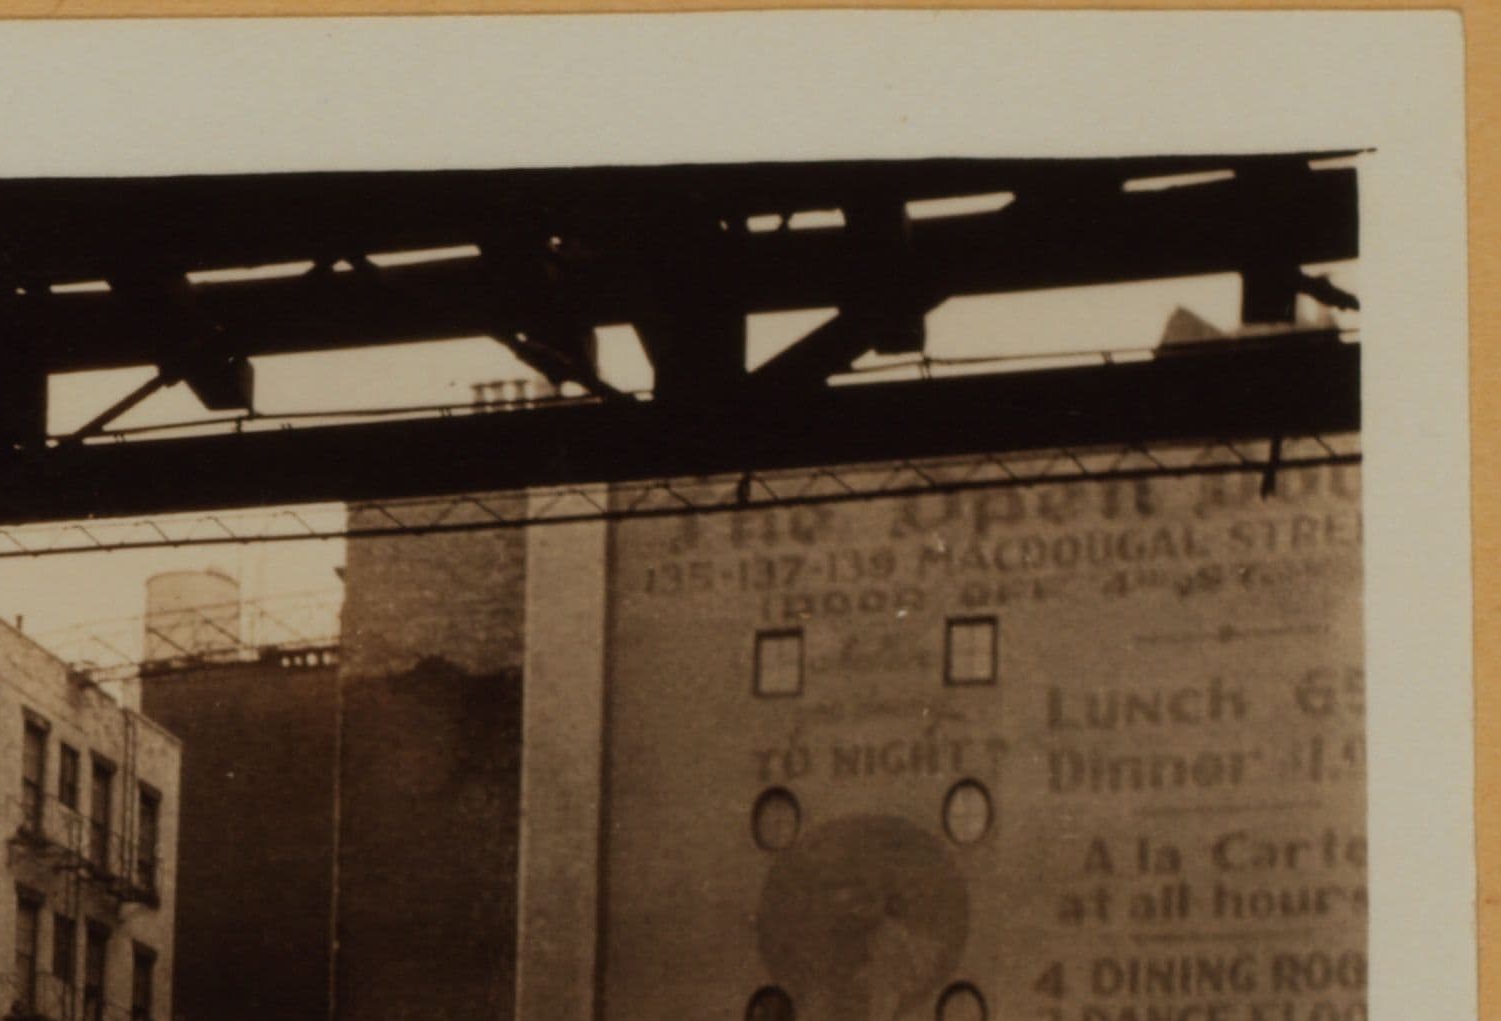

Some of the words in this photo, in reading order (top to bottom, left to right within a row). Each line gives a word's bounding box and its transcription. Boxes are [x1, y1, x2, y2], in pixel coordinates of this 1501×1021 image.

[917, 524, 1209, 577] MACDOUGAL
[1228, 512, 1362, 553] STRE
[1129, 878, 1191, 921] all
[1033, 960, 1065, 999] 4
[1090, 953, 1257, 997] DINING
